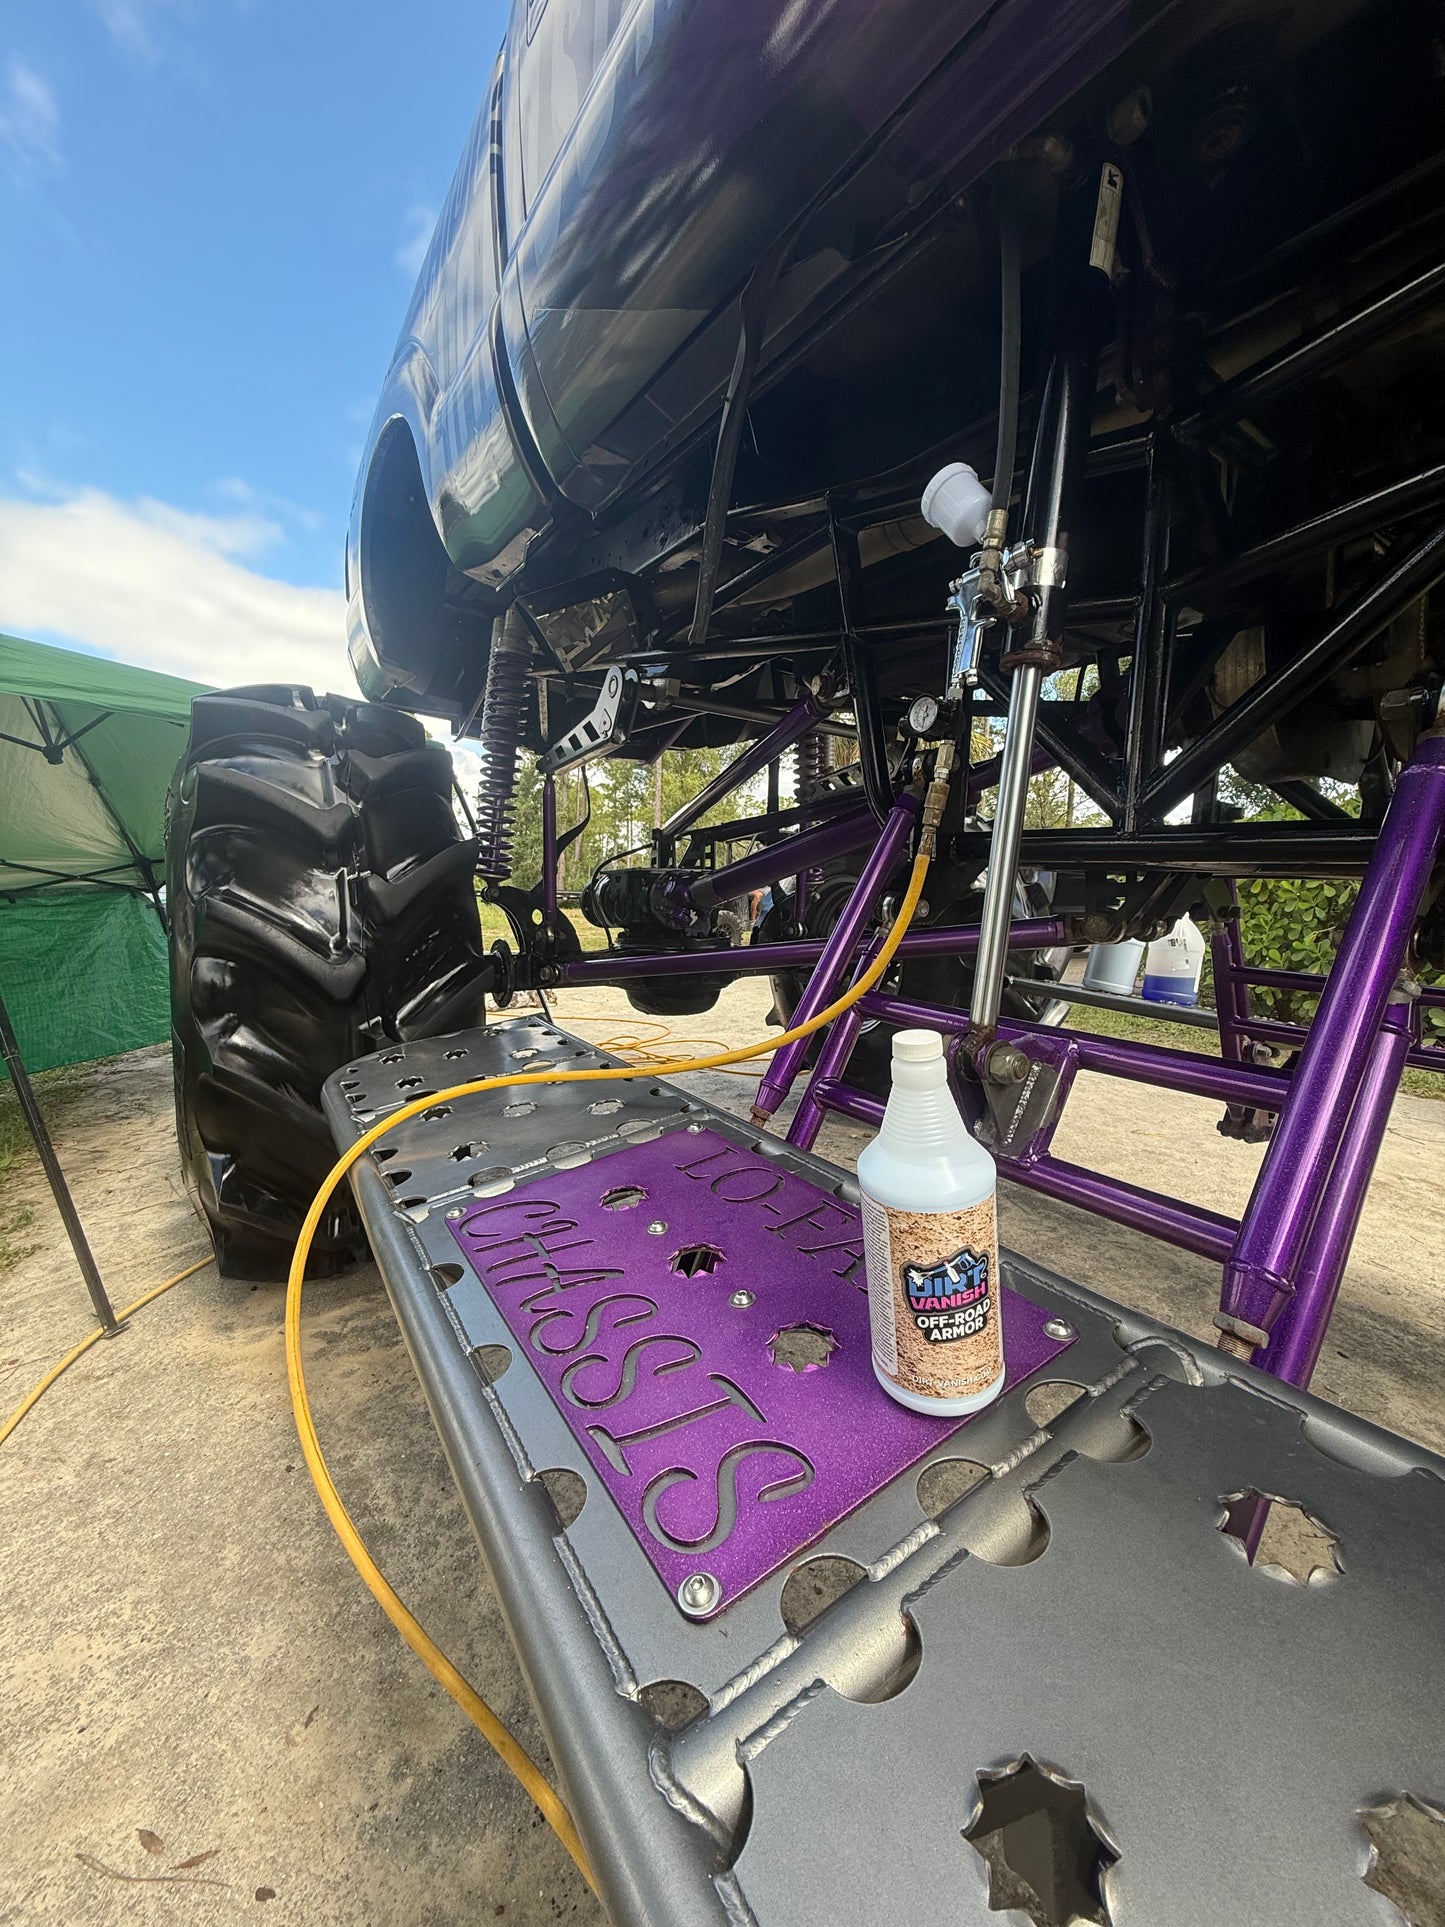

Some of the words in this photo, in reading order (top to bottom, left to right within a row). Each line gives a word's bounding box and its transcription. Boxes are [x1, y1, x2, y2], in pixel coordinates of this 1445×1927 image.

[674, 1146, 868, 1296] LO-FA
[908, 1263, 985, 1297] DIRT
[910, 1281, 986, 1310] VANISH
[917, 1298, 991, 1329] OFF-ROAD
[929, 1316, 984, 1341] ARMOR
[461, 1200, 815, 1554] CHASSIS
